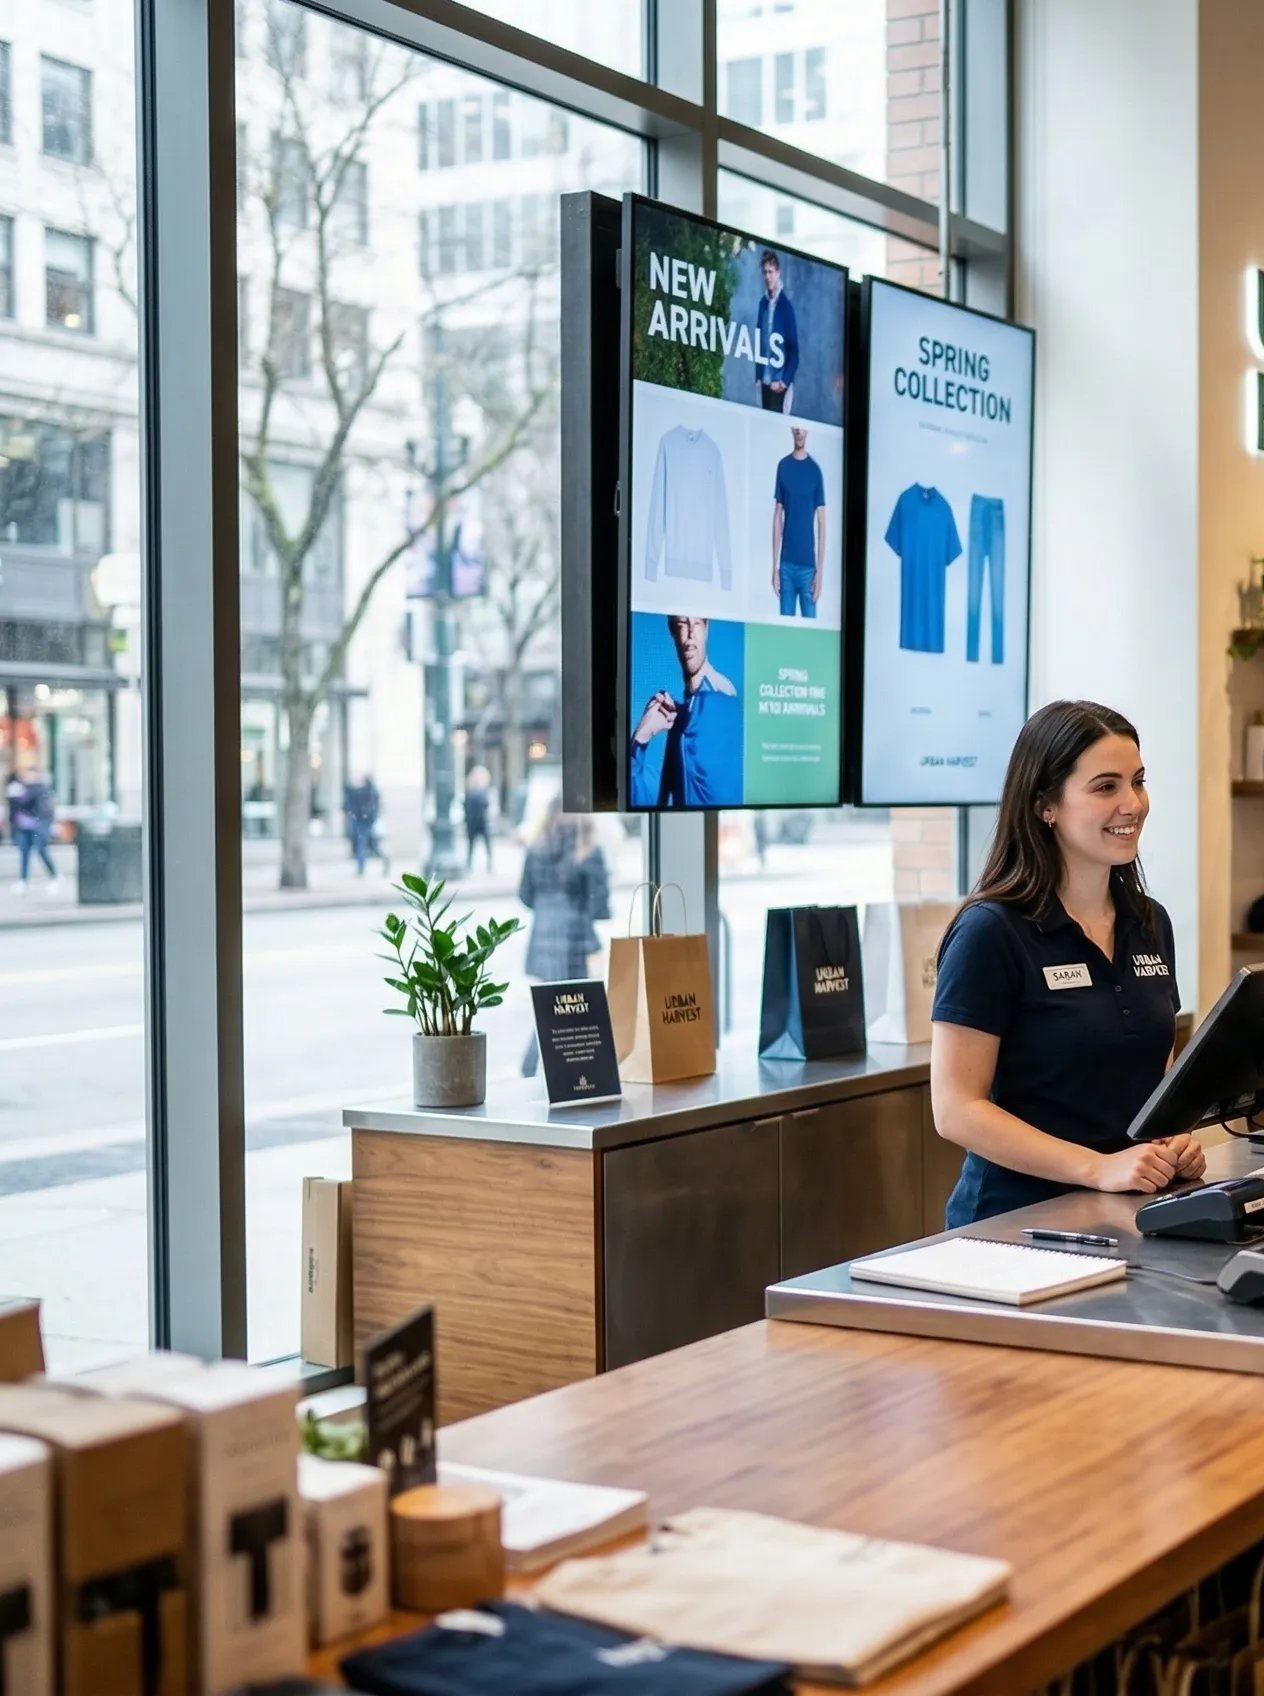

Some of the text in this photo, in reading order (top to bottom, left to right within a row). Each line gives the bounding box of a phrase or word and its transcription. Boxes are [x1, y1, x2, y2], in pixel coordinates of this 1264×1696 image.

[649, 251, 717, 307] NEW
[647, 299, 785, 369] ARRIVALS
[918, 336, 991, 383] SPRING
[893, 366, 1012, 424] COLLECTION
